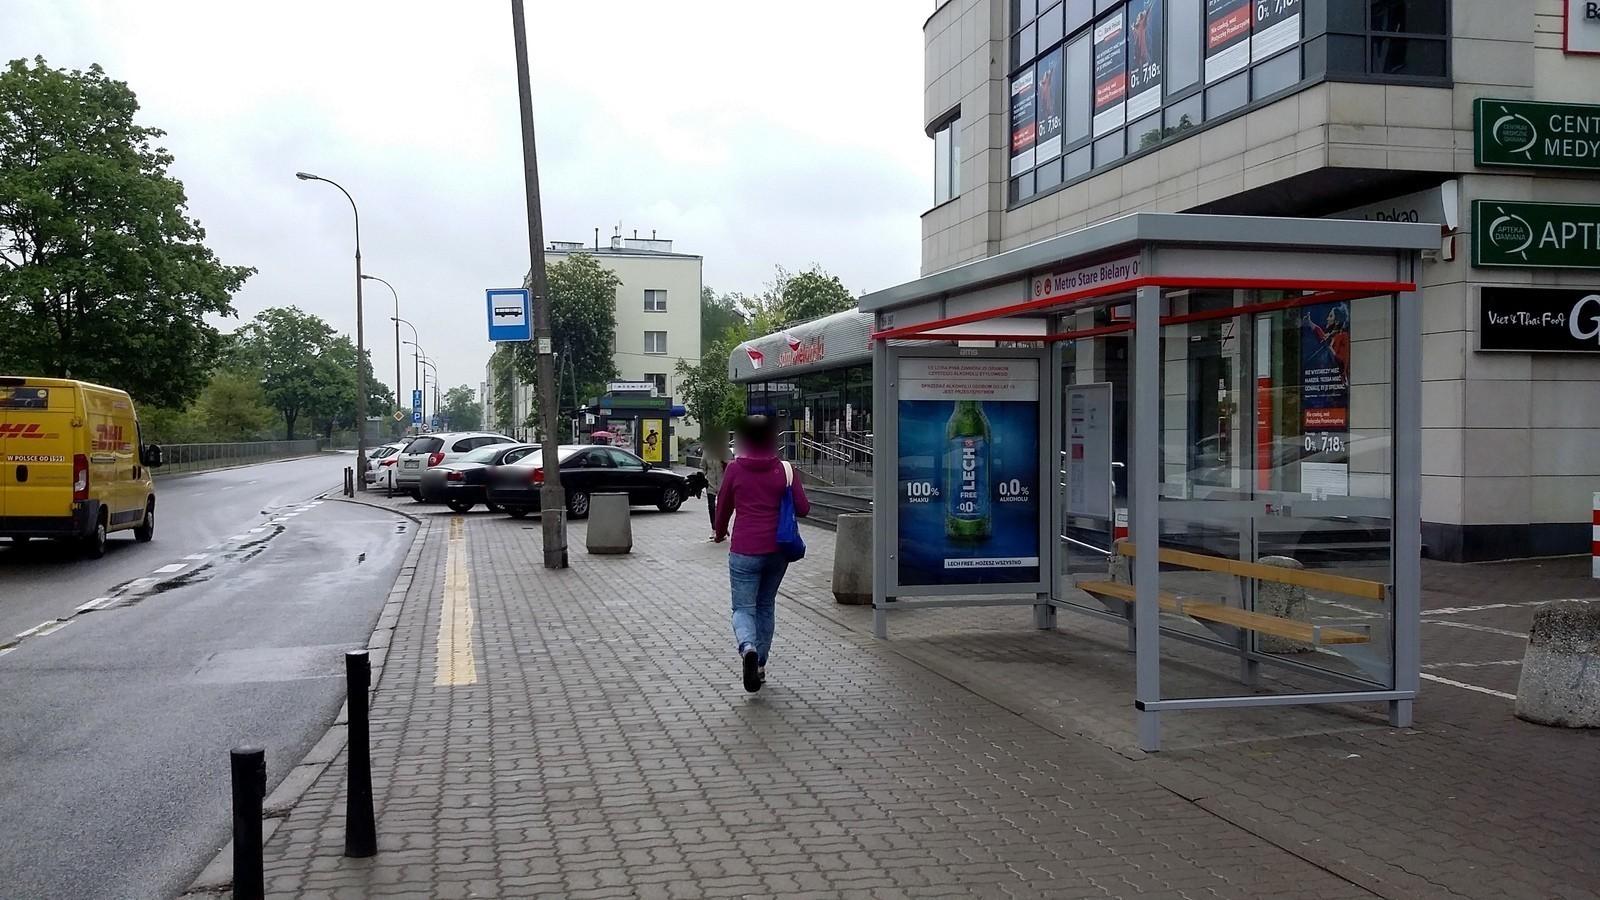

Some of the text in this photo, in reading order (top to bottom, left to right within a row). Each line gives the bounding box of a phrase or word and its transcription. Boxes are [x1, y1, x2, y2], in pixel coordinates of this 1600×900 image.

[1257, 5, 1269, 21] 0%
[1142, 63, 1160, 84] 7,18%
[1549, 114, 1600, 134] CENT
[1545, 138, 1600, 157] MEDY
[1539, 221, 1600, 250] APT
[1054, 260, 1141, 291] Metro Stare Bielany 0
[1517, 311, 1541, 326] Thai
[1542, 312, 1566, 327] Food
[1305, 436, 1345, 454] 0% 7,18%
[963, 447, 975, 490] LECH
[907, 482, 939, 496] 100%
[999, 479, 1029, 496] 0,0%
